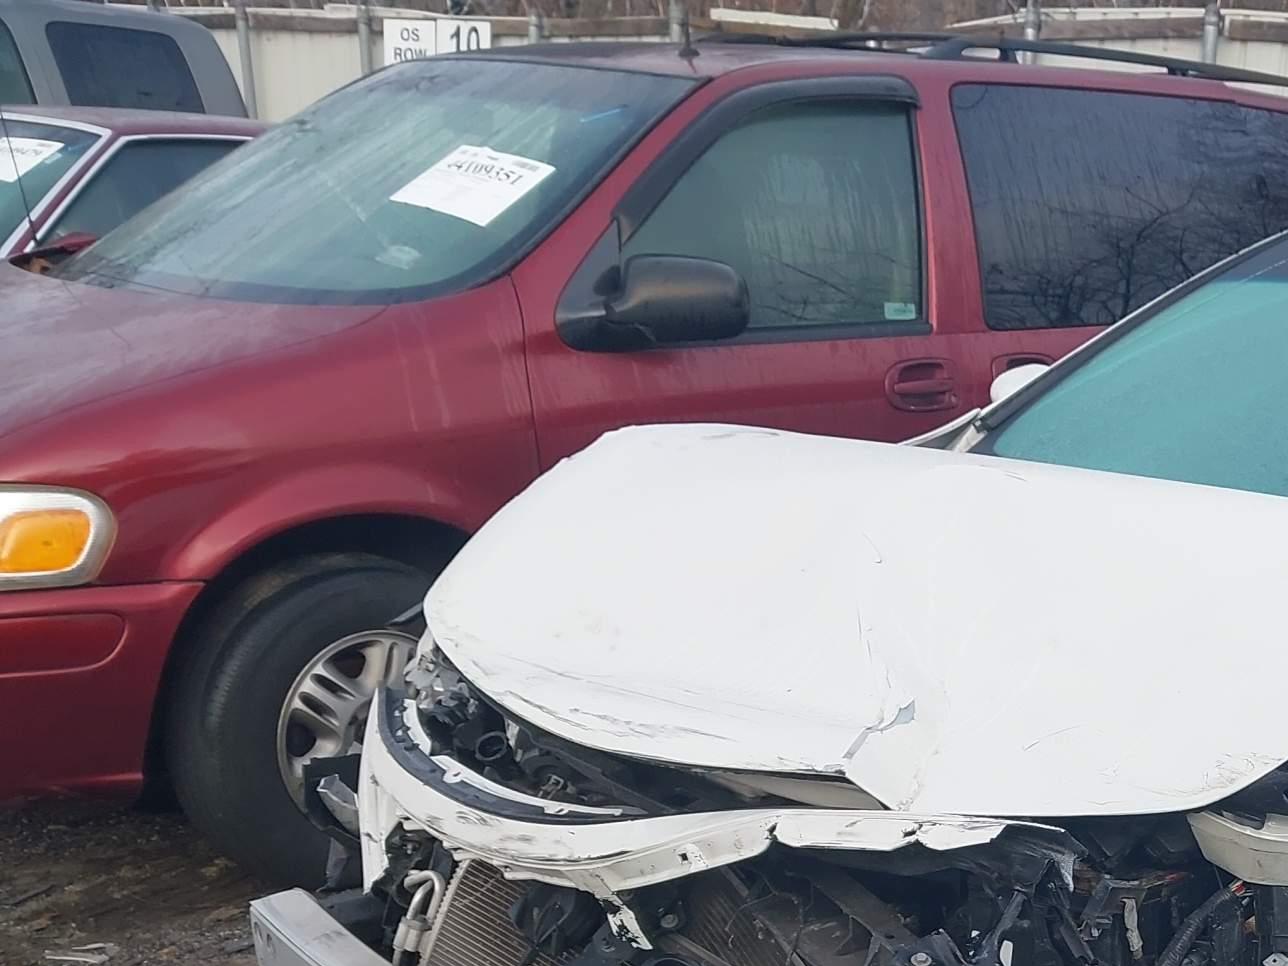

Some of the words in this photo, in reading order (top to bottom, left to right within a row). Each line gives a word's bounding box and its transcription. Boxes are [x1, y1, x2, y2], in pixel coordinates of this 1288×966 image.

[400, 28, 420, 42] OS
[450, 24, 481, 52] 10
[393, 47, 427, 61] ROW
